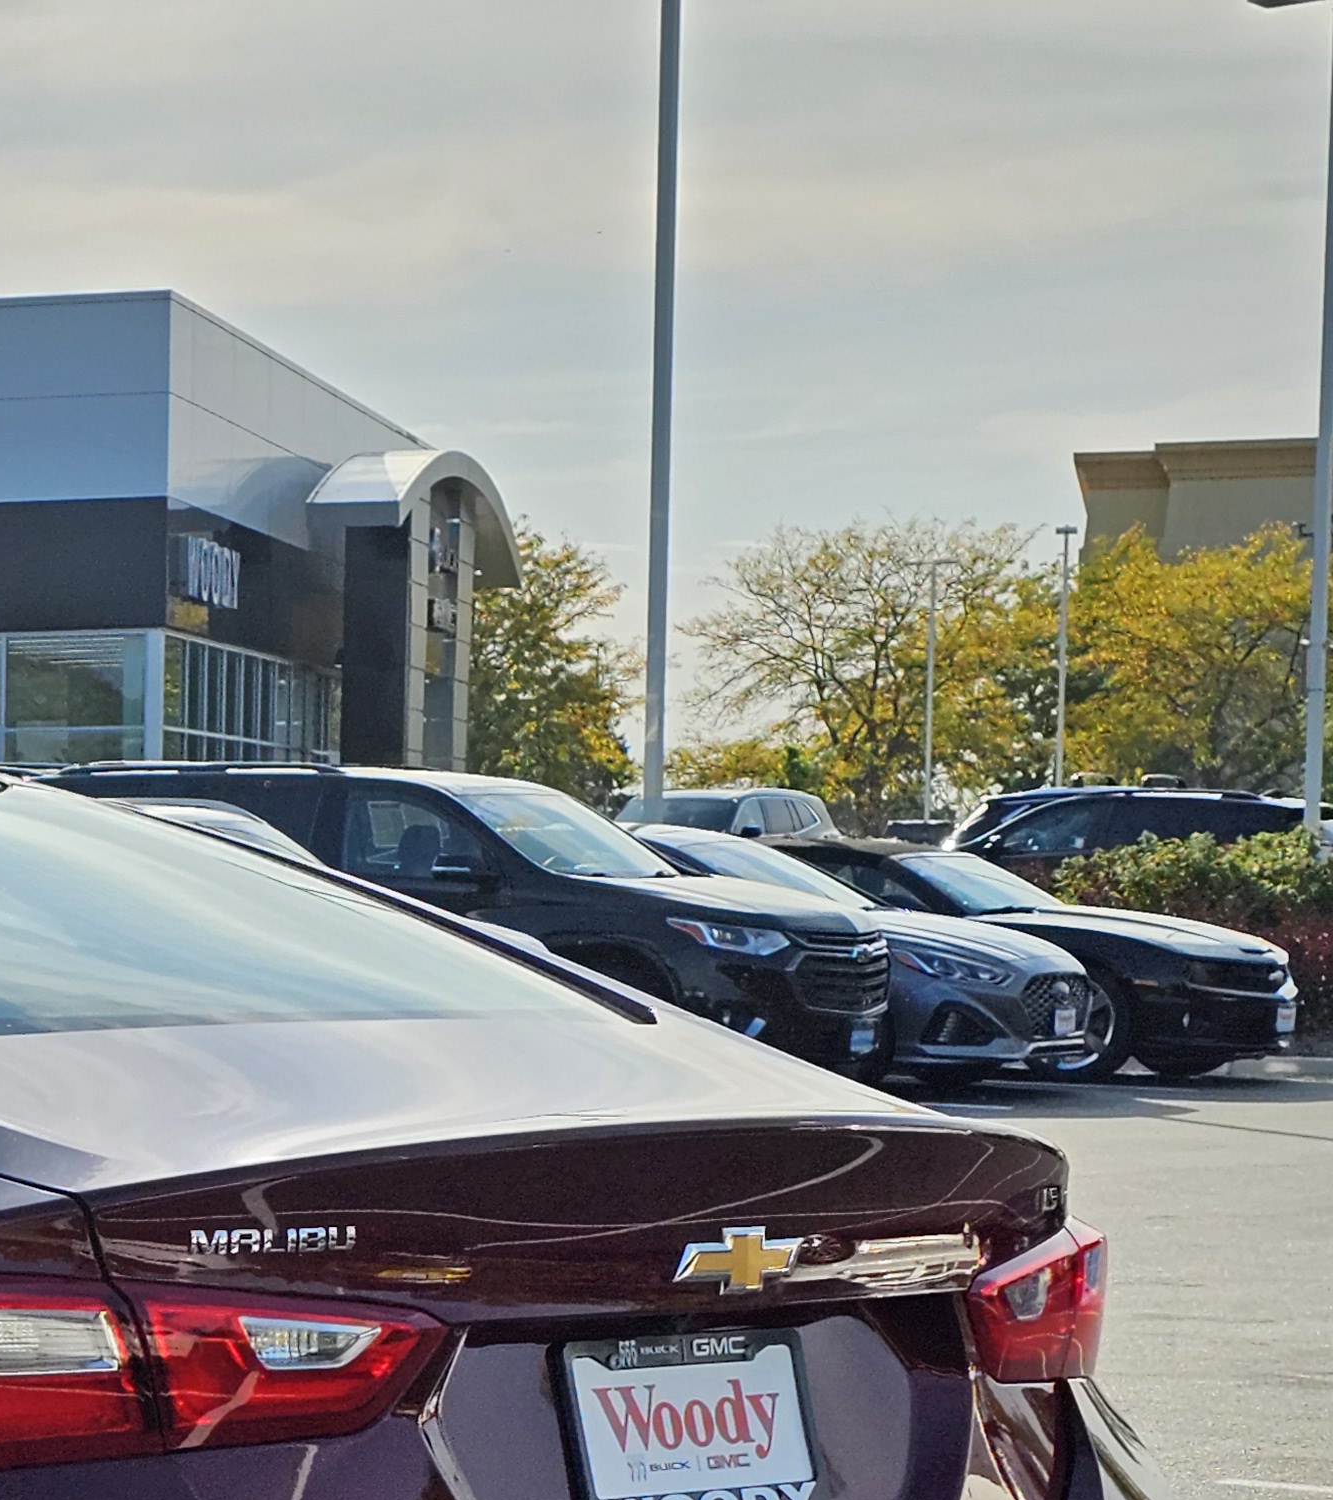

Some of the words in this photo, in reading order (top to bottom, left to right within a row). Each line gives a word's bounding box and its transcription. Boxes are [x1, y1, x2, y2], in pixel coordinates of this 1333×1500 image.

[187, 535, 241, 610] WOODY
[190, 1225, 356, 1255] MALIBU
[692, 1335, 746, 1357] GMC
[591, 1378, 779, 1459] Woody
[649, 1460, 691, 1472] BUICK
[706, 1453, 751, 1470] GMC
